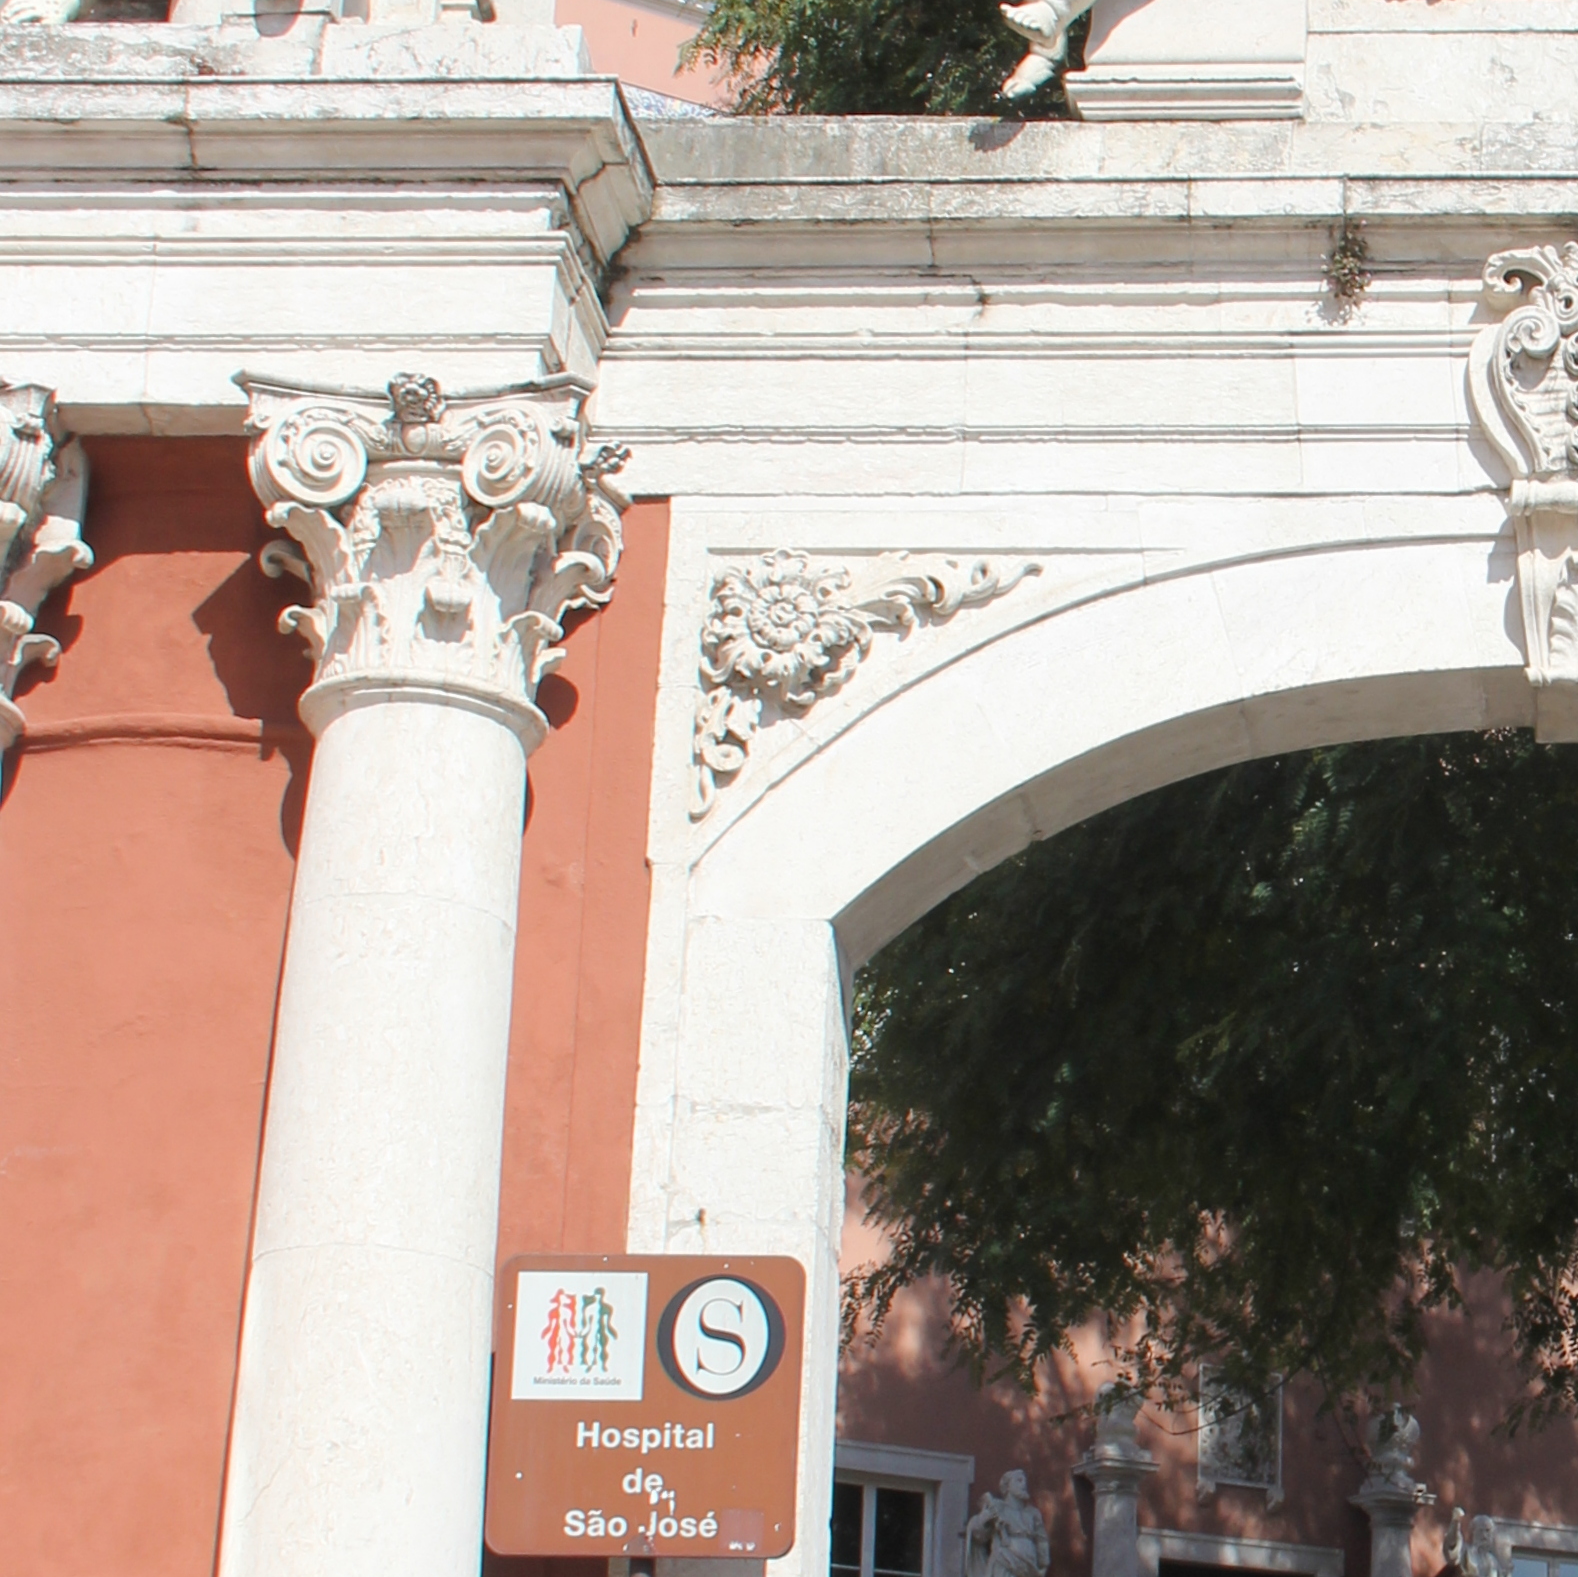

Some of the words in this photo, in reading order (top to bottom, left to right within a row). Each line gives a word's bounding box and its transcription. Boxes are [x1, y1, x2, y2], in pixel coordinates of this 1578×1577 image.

[533, 1376, 578, 1386] Ministério
[579, 1376, 591, 1386] da
[593, 1376, 622, 1386] Saúde
[575, 1421, 715, 1454] Hospital
[622, 1467, 664, 1494] de
[563, 1509, 628, 1537] São
[639, 1511, 719, 1538] José
